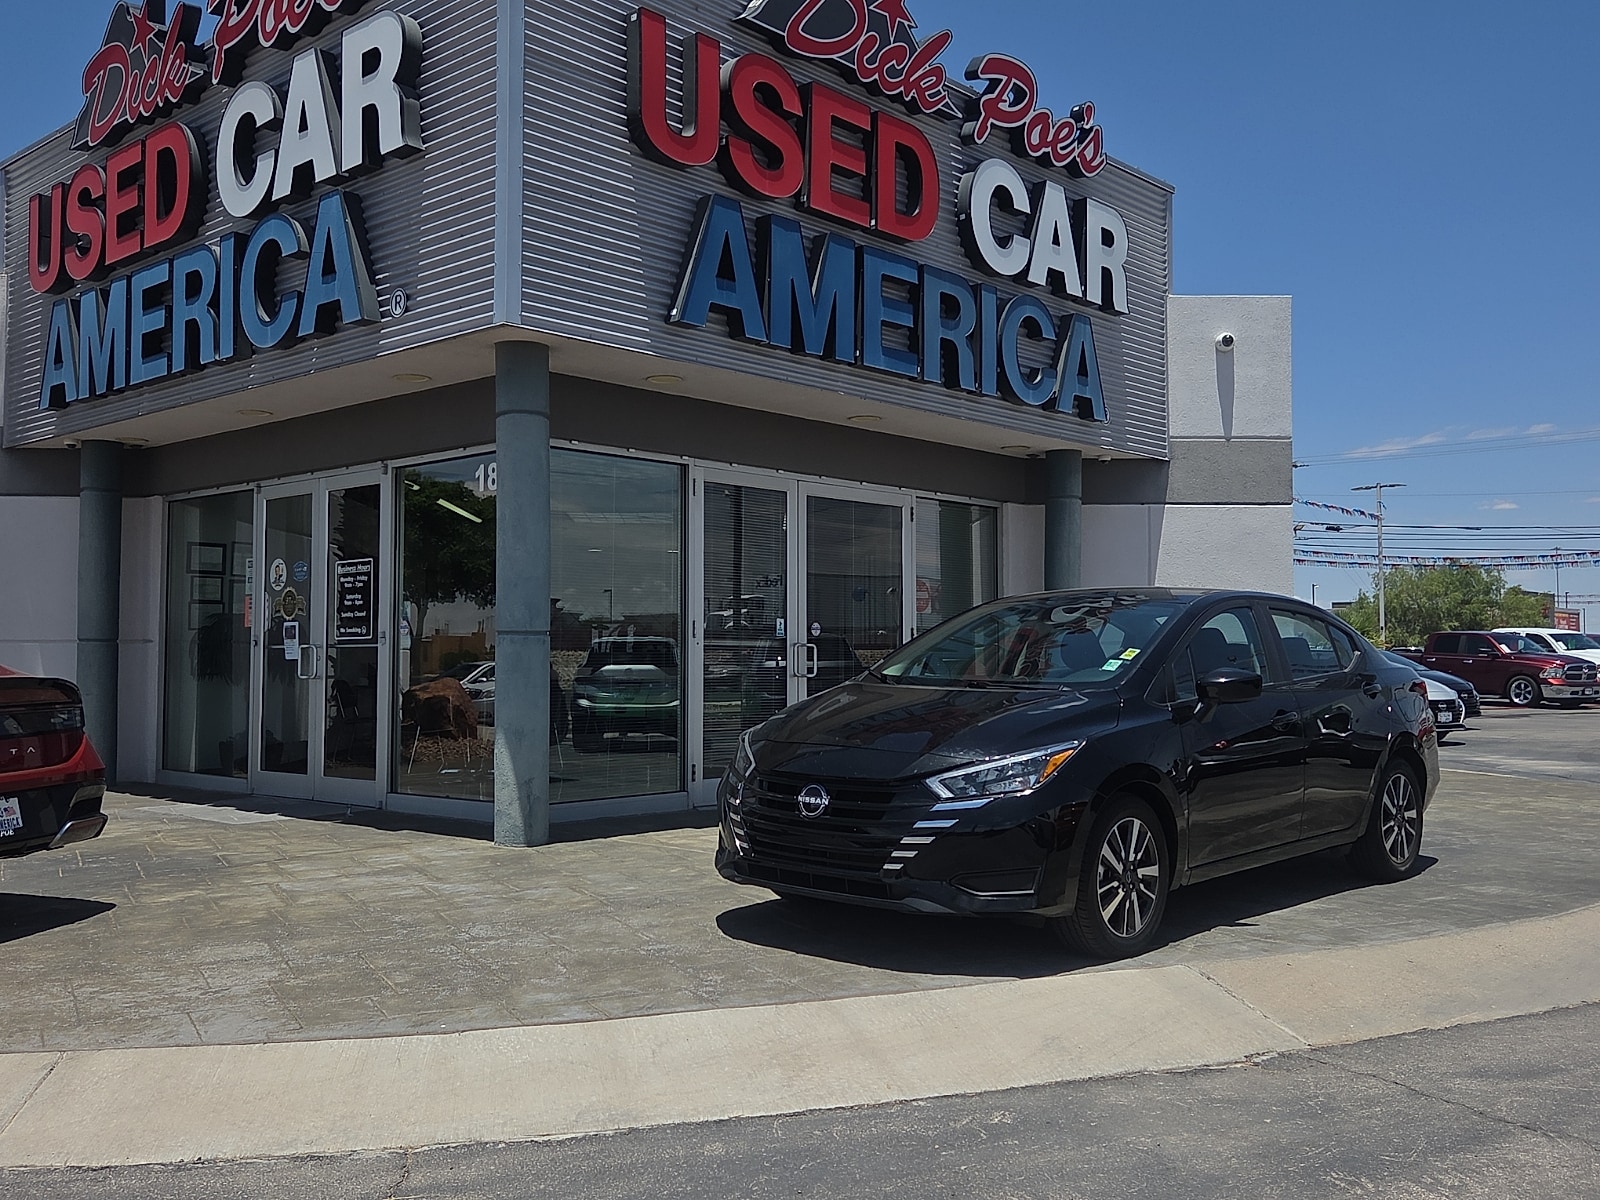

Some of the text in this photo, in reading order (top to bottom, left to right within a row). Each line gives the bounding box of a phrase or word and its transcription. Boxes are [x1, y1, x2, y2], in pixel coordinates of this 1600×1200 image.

[29, 10, 402, 293] USED CAR
[82, 2, 193, 146] Dick
[639, 7, 1130, 315] USED CAR
[978, 53, 1107, 177] Poe's
[39, 191, 365, 410] AMERICA
[678, 194, 1107, 422] AMERICA
[797, 794, 829, 805] NISSAN
